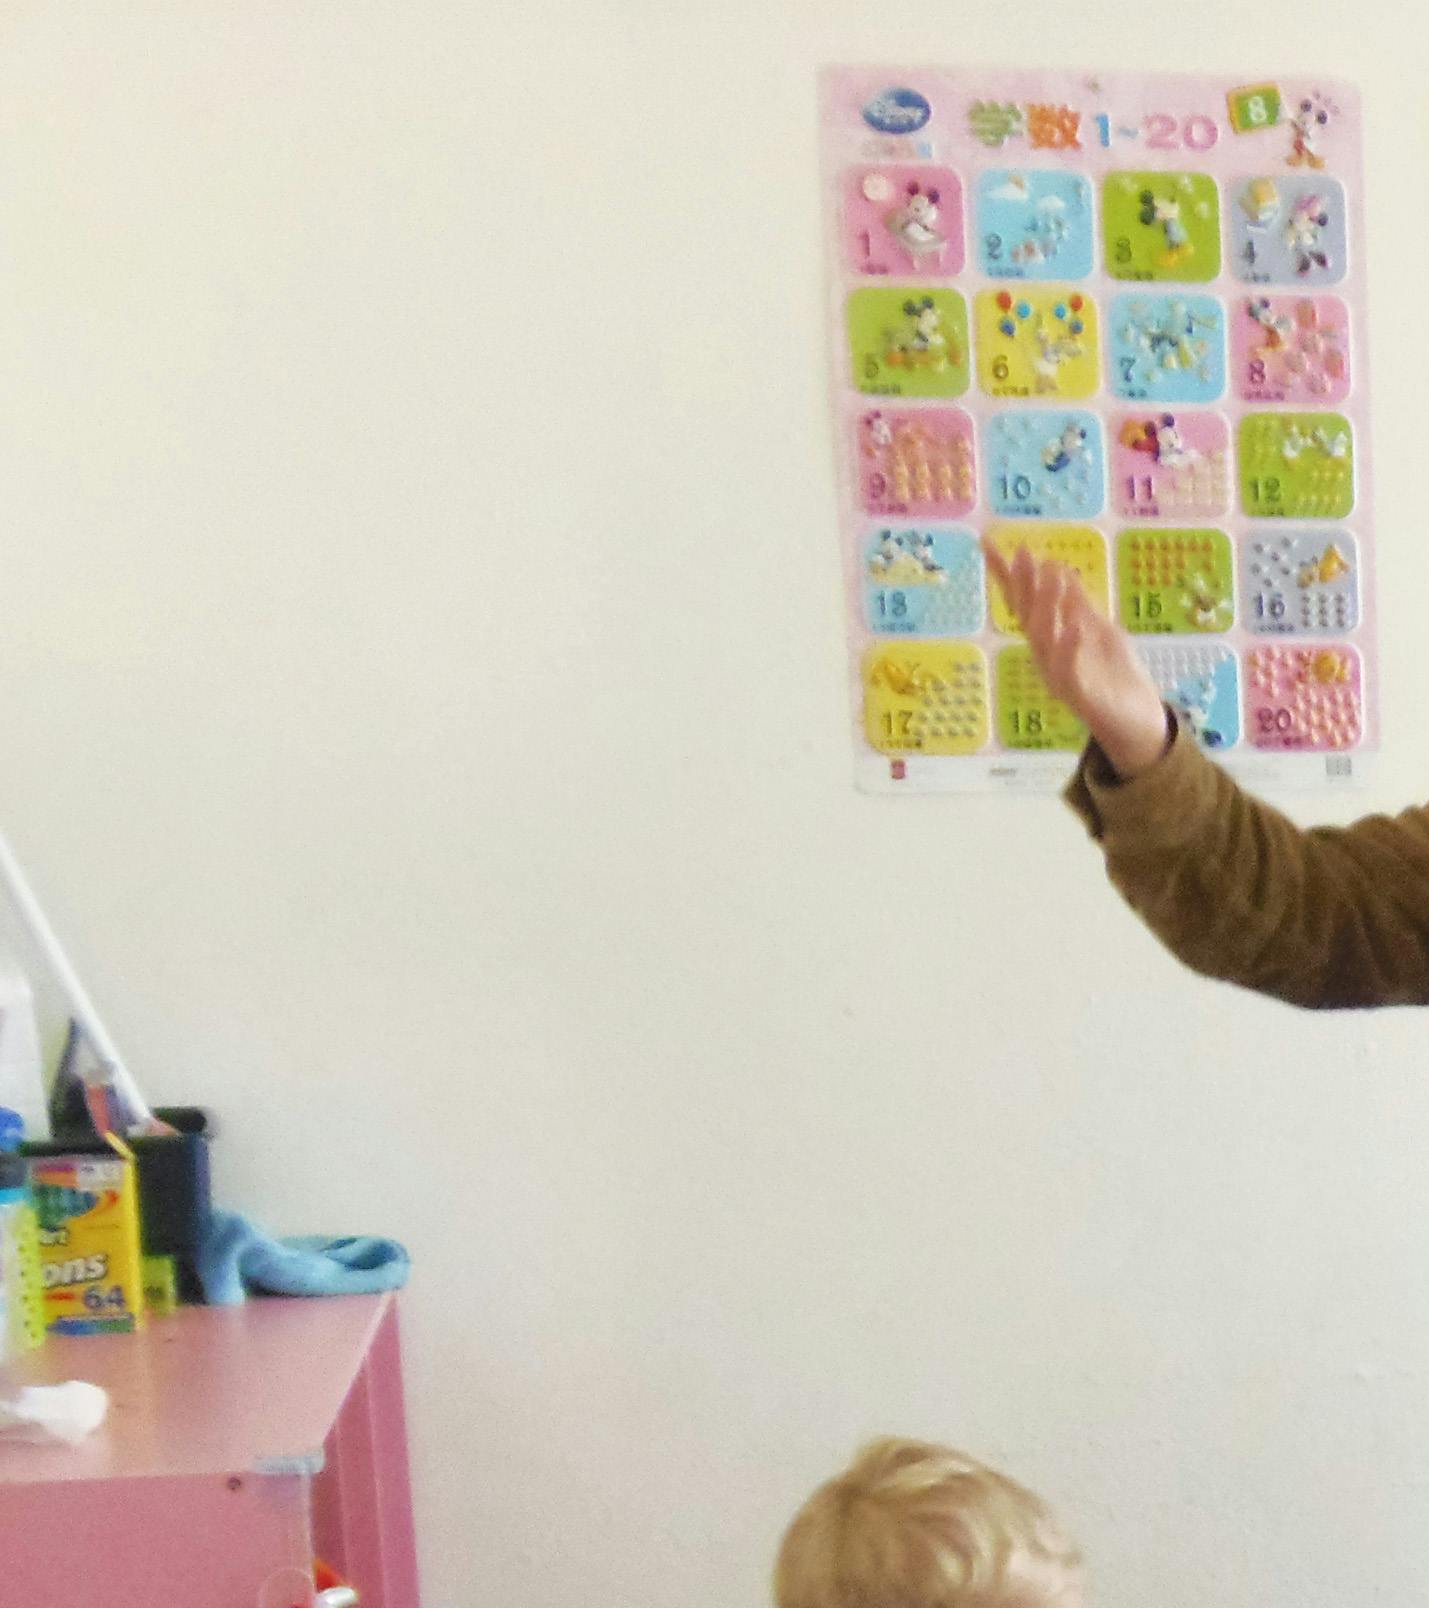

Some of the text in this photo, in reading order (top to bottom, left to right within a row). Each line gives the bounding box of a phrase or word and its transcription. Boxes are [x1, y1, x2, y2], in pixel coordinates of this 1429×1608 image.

[985, 232, 1003, 260] 2
[992, 354, 1010, 381] 6
[1119, 356, 1137, 383] 7
[1249, 358, 1267, 385] 8
[999, 473, 1032, 500] 10
[1126, 475, 1154, 500] 11
[876, 590, 908, 617] 13
[1130, 592, 1163, 619] 15
[1254, 591, 1286, 619] 16
[882, 710, 913, 735] 17
[1009, 710, 1043, 734] 18
[1257, 707, 1292, 733] 20
[83, 1283, 126, 1312] 64
